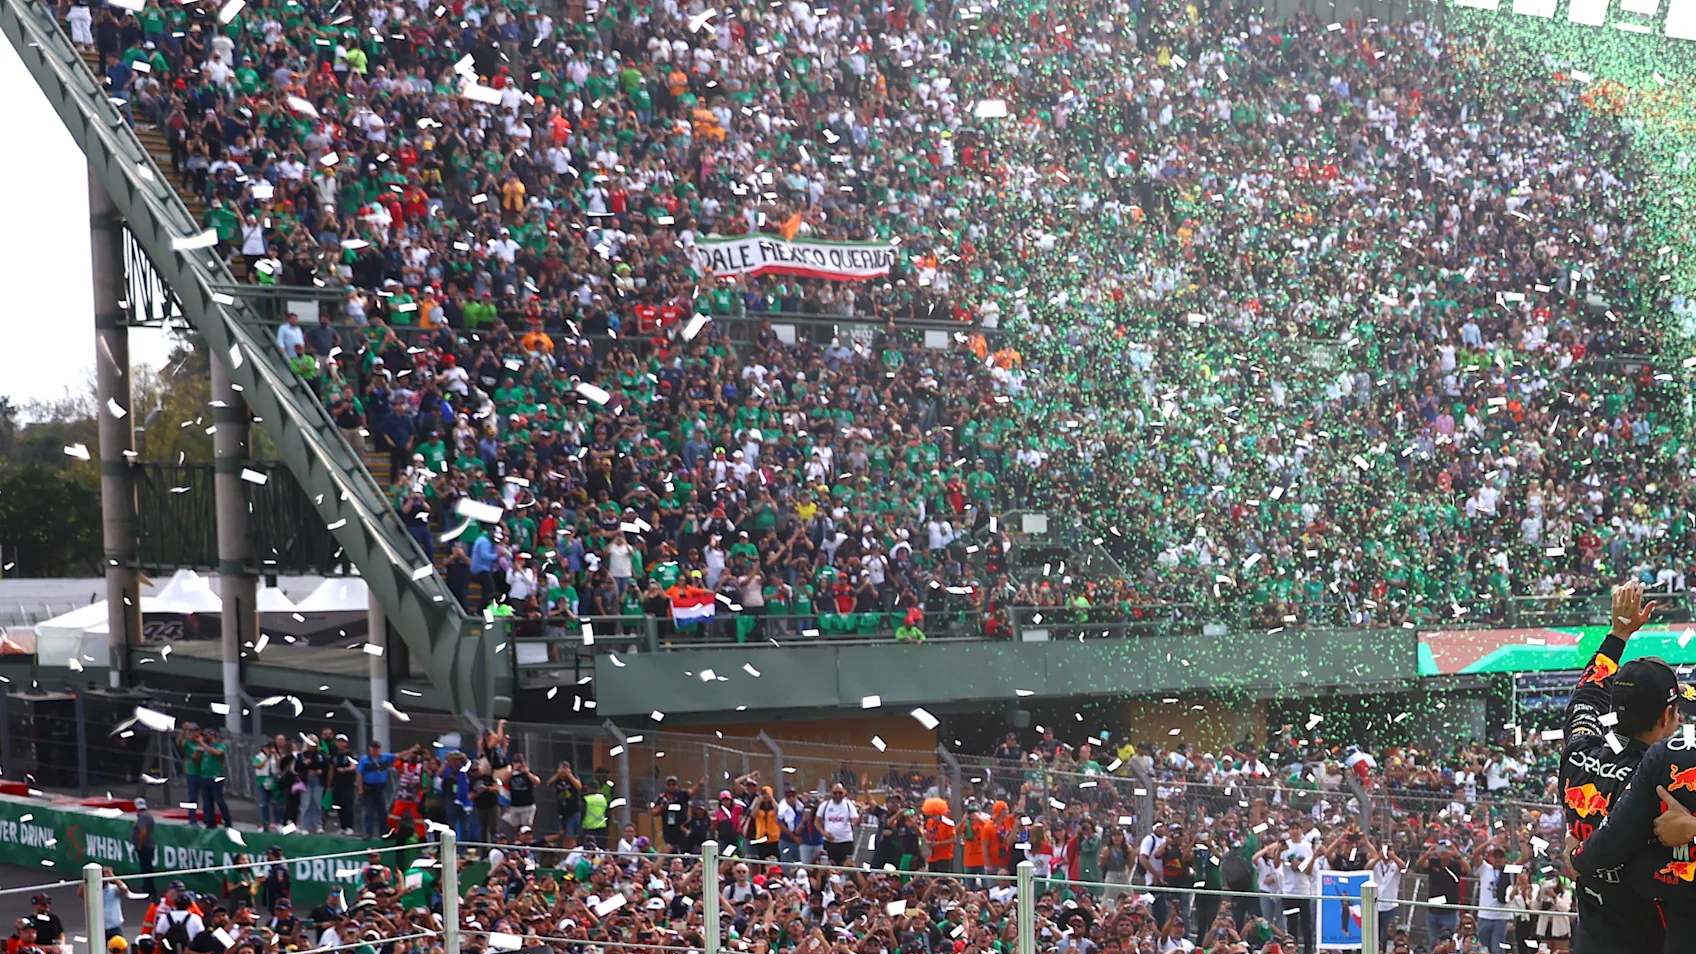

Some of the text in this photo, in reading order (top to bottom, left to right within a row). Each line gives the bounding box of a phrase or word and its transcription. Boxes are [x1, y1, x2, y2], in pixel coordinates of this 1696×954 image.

[702, 245, 756, 271] DALE
[760, 240, 826, 269] MEXICO
[1568, 751, 1633, 782] ORACLE
[86, 834, 122, 861] WHEN
[164, 845, 216, 873] DRIVE
